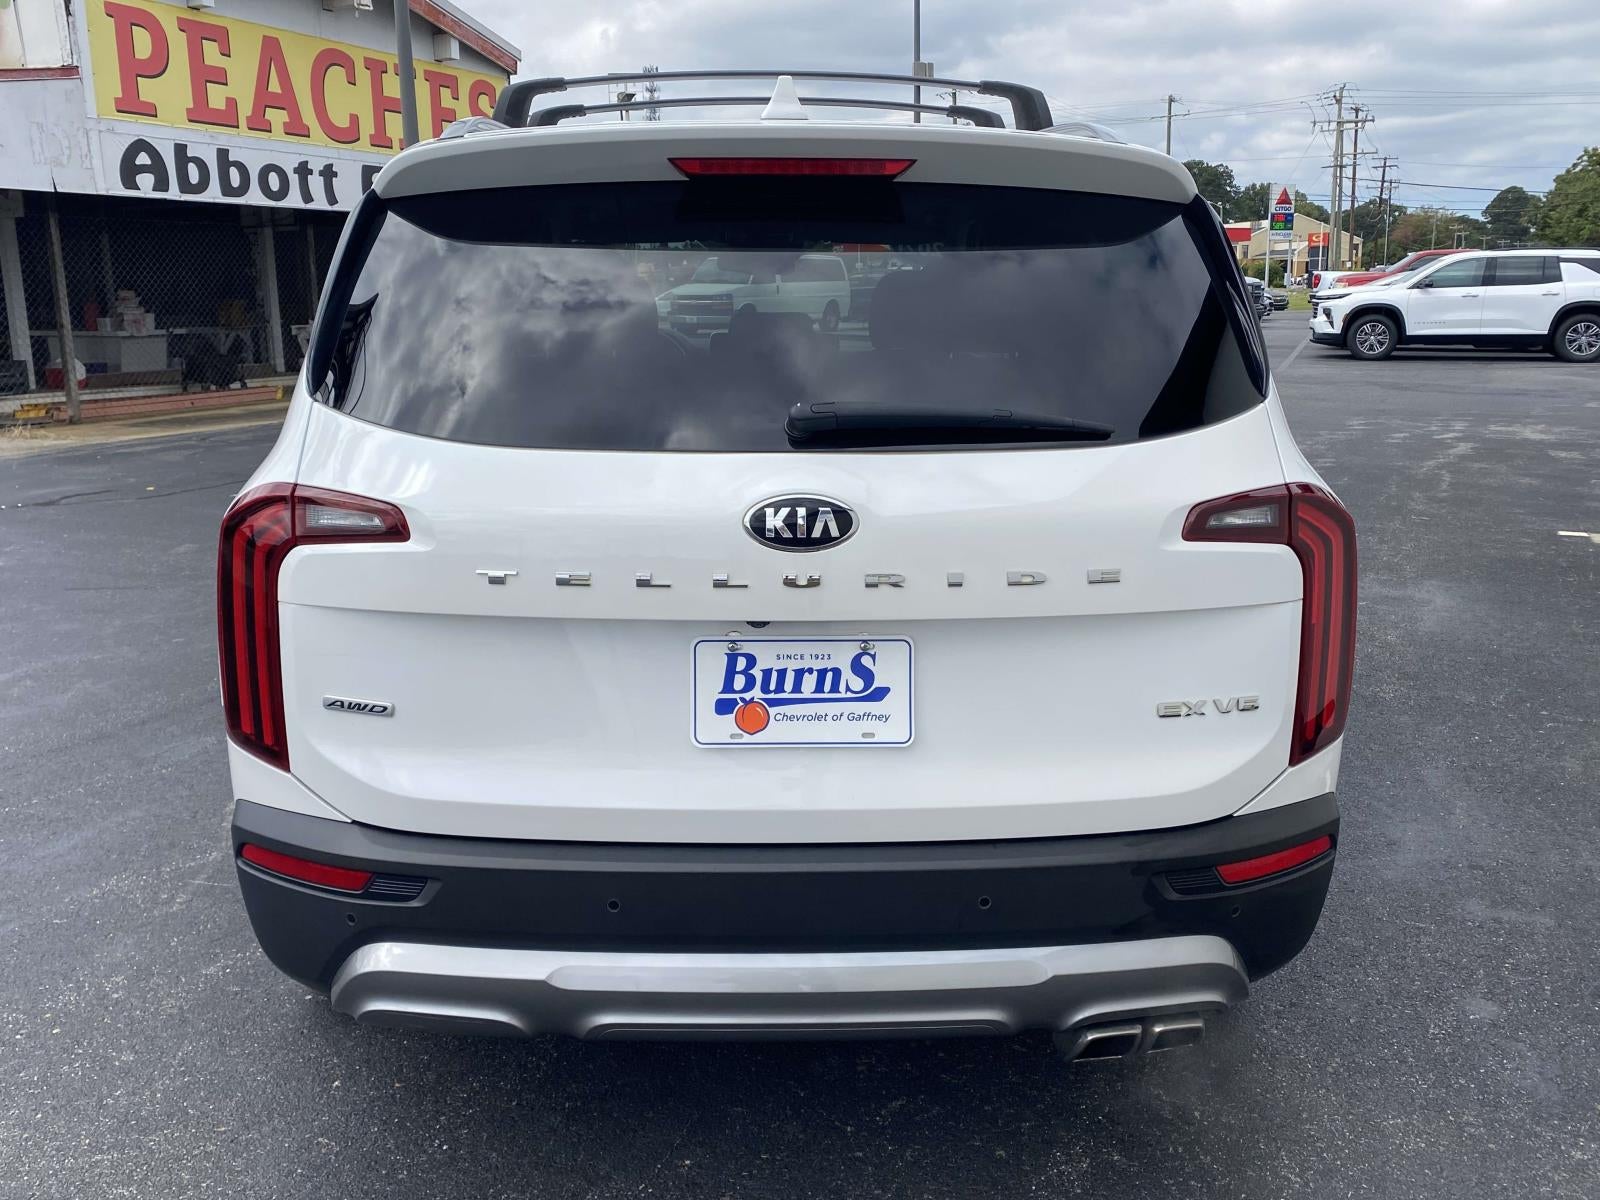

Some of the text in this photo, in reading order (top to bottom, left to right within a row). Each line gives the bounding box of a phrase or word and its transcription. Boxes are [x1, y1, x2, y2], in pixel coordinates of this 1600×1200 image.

[119, 137, 338, 206] Abbott
[764, 507, 840, 538] KIA
[476, 567, 1122, 589] TELLURIDE
[776, 653, 832, 661] SINCE 1923
[326, 700, 389, 714] AWD
[773, 712, 891, 724] Chevrolet of Gaffney
[1157, 696, 1260, 718] EX V6
